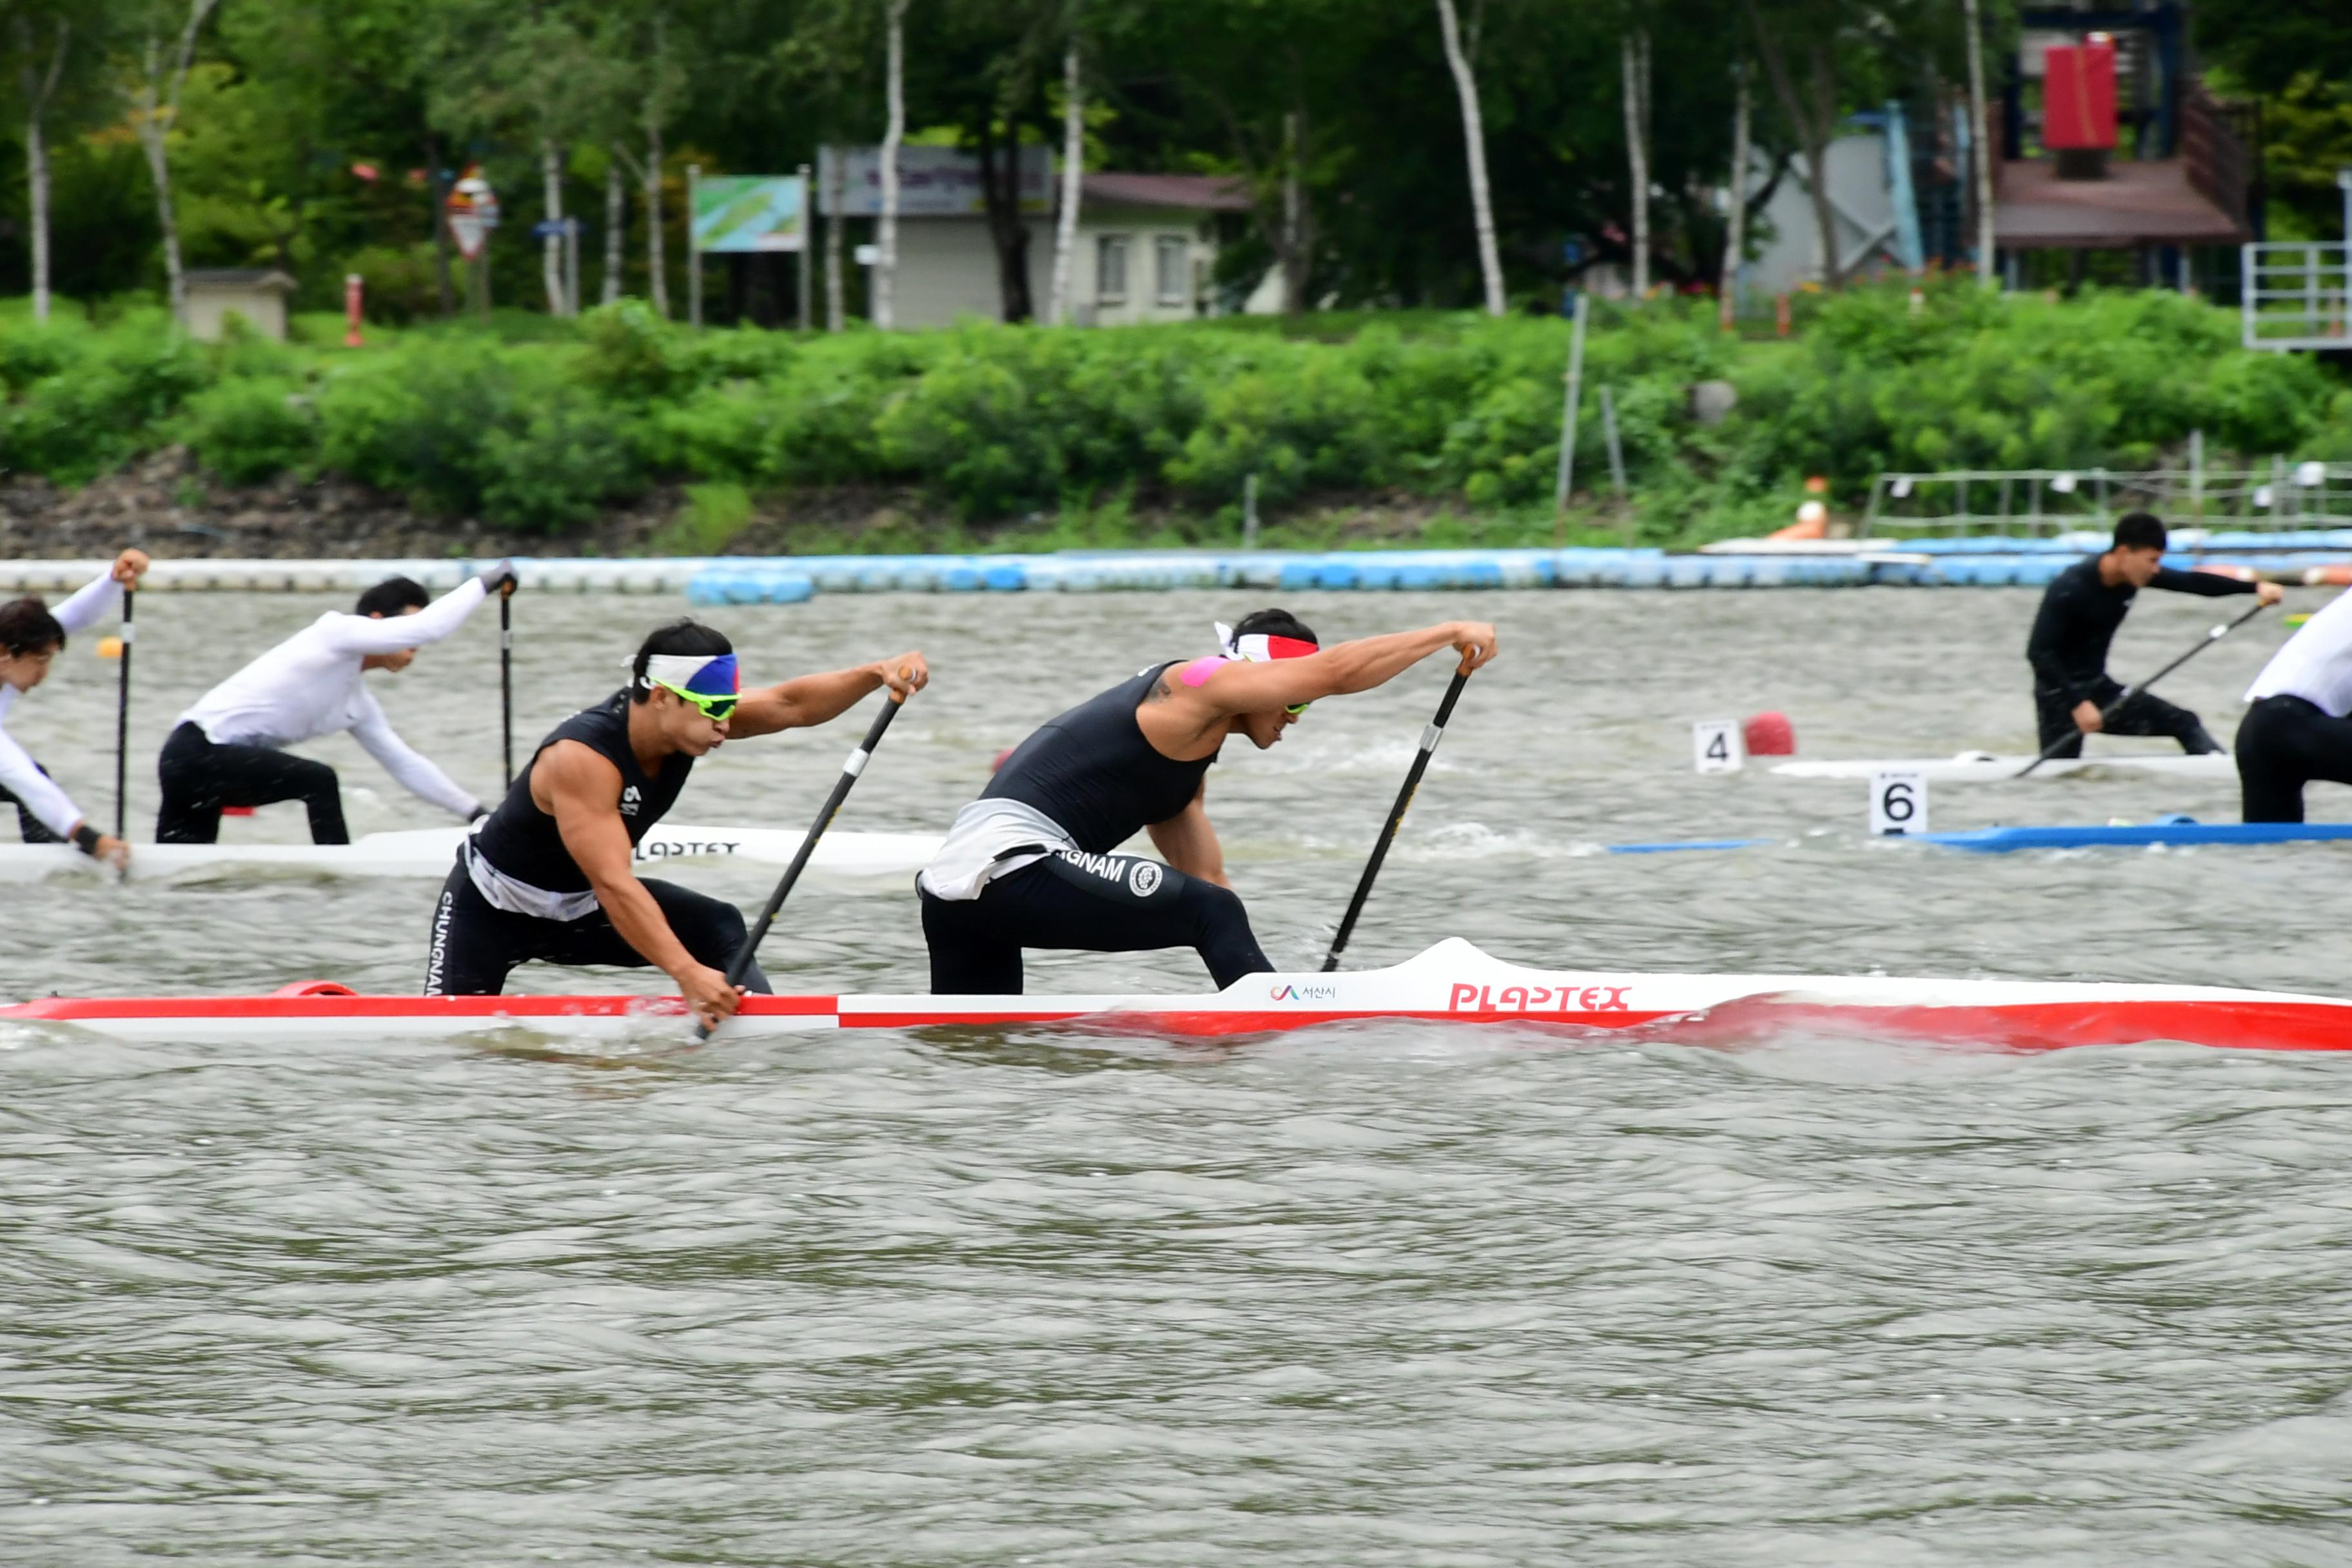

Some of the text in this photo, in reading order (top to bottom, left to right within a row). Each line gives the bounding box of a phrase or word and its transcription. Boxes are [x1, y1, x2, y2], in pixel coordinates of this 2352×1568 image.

[1706, 732, 1729, 761] 4
[1883, 783, 1914, 821] 6
[1059, 850, 1127, 883] GNAM
[1302, 986, 1336, 999] 서산시
[1449, 983, 1632, 1011] PLASTEX
